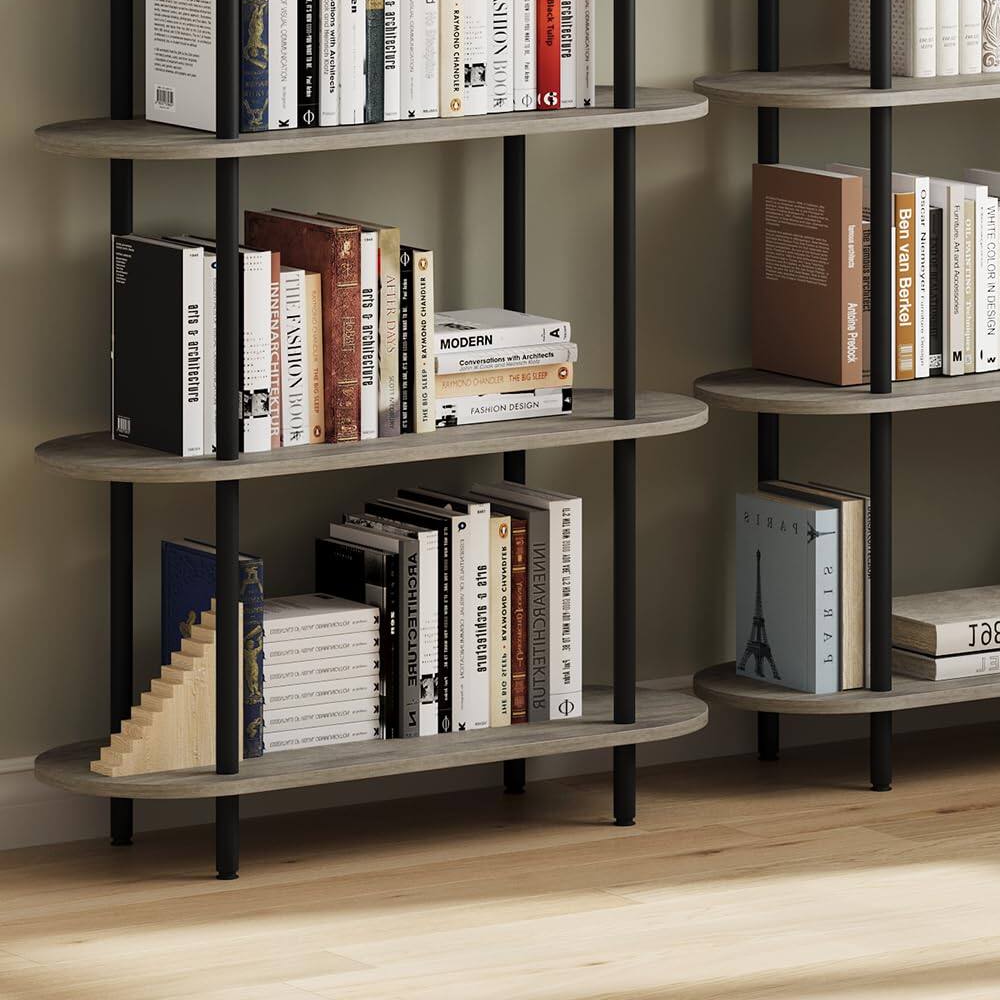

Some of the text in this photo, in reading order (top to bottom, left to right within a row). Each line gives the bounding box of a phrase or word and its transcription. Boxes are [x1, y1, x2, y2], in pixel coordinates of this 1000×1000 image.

[545, 25, 555, 46] Tulip
[547, 0, 555, 22] Black
[562, 1, 573, 58] architecture
[385, 12, 397, 69] architecture
[493, 61, 508, 107] BOOK
[899, 209, 912, 326] Ben van Berkel
[987, 206, 997, 335] WHITE COLOR IN DESIGN
[188, 305, 200, 324] arts
[363, 289, 375, 308] arts
[387, 275, 397, 353] AFTER DAYS
[271, 282, 280, 436] INNENARCHITEKTUR
[286, 274, 304, 440] THE FASHION BOOK
[363, 325, 375, 386] architecture
[440, 335, 493, 350] MODERN
[459, 356, 505, 366] Conversations
[522, 351, 554, 360] Architects
[848, 303, 858, 363] Antoine Predock
[188, 341, 200, 402] architecture
[470, 402, 539, 415] FASHION DESIGN
